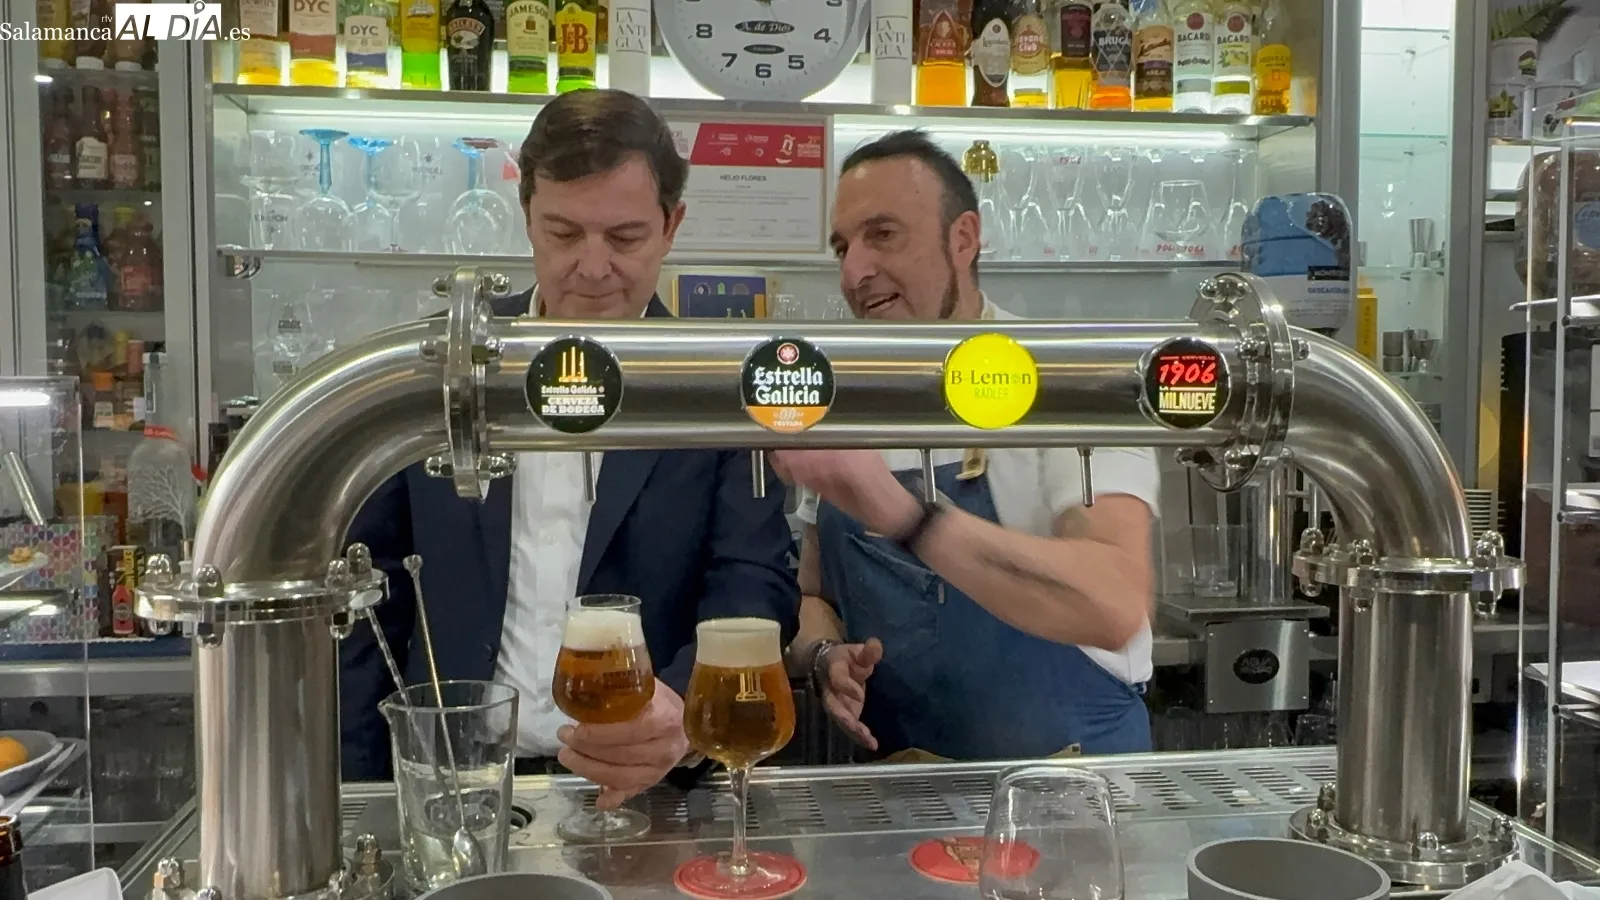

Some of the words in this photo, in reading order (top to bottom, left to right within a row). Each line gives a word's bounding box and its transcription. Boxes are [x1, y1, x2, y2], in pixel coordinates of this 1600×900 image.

[294, 0, 330, 14] DYC
[616, 11, 633, 23] LA
[350, 25, 379, 36] DYC
[696, 23, 713, 39] 8
[754, 21, 766, 32] de
[769, 22, 791, 33] Dios
[876, 20, 892, 32] LA
[814, 28, 831, 43] 4
[615, 37, 645, 50] GUA
[875, 46, 903, 57] GUA
[721, 53, 738, 68] 7
[788, 55, 804, 70] 5
[755, 64, 772, 79] 6
[753, 366, 823, 386] Estrella
[1159, 362, 1216, 385] 1906
[755, 385, 820, 405] Galicia
[974, 387, 1008, 399] RADLER
[548, 397, 599, 405] CERVEZA
[1159, 392, 1216, 410] MILNUEVE
[542, 405, 557, 413] DE
[559, 405, 605, 413] BODEGA
